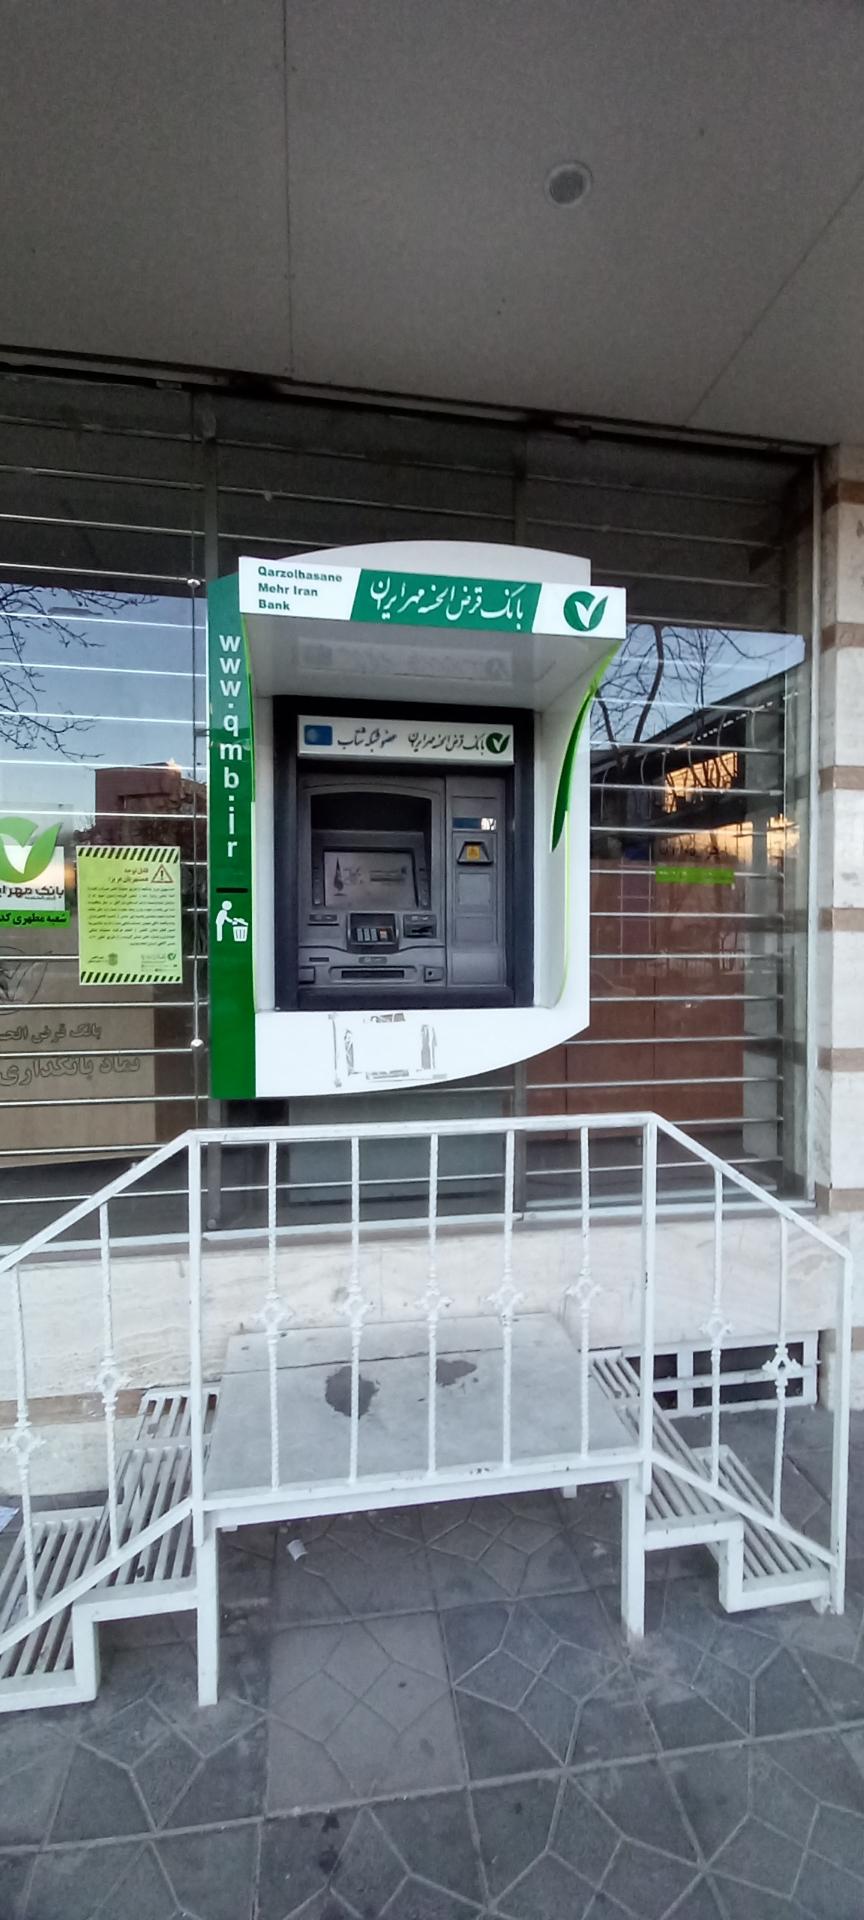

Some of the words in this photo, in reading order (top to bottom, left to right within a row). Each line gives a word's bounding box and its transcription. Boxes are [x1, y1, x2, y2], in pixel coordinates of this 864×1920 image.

[258, 566, 343, 582] Qarzolhasane
[258, 583, 290, 594] Mehr
[293, 585, 318, 597] Iran
[370, 576, 406, 620] ایران
[258, 599, 290, 611] Bank
[397, 588, 425, 613] مهر
[446, 586, 483, 620] قرض
[481, 584, 526, 630] بانک
[219, 634, 243, 858] www.qmb.ir
[337, 726, 366, 750] شتاب
[380, 729, 398, 749] عضو
[7, 886, 33, 898] مهر
[35, 885, 65, 899] بانک
[12, 912, 46, 925] مطهری
[46, 913, 67, 925] شعبه
[69, 1022, 102, 1041] بانک
